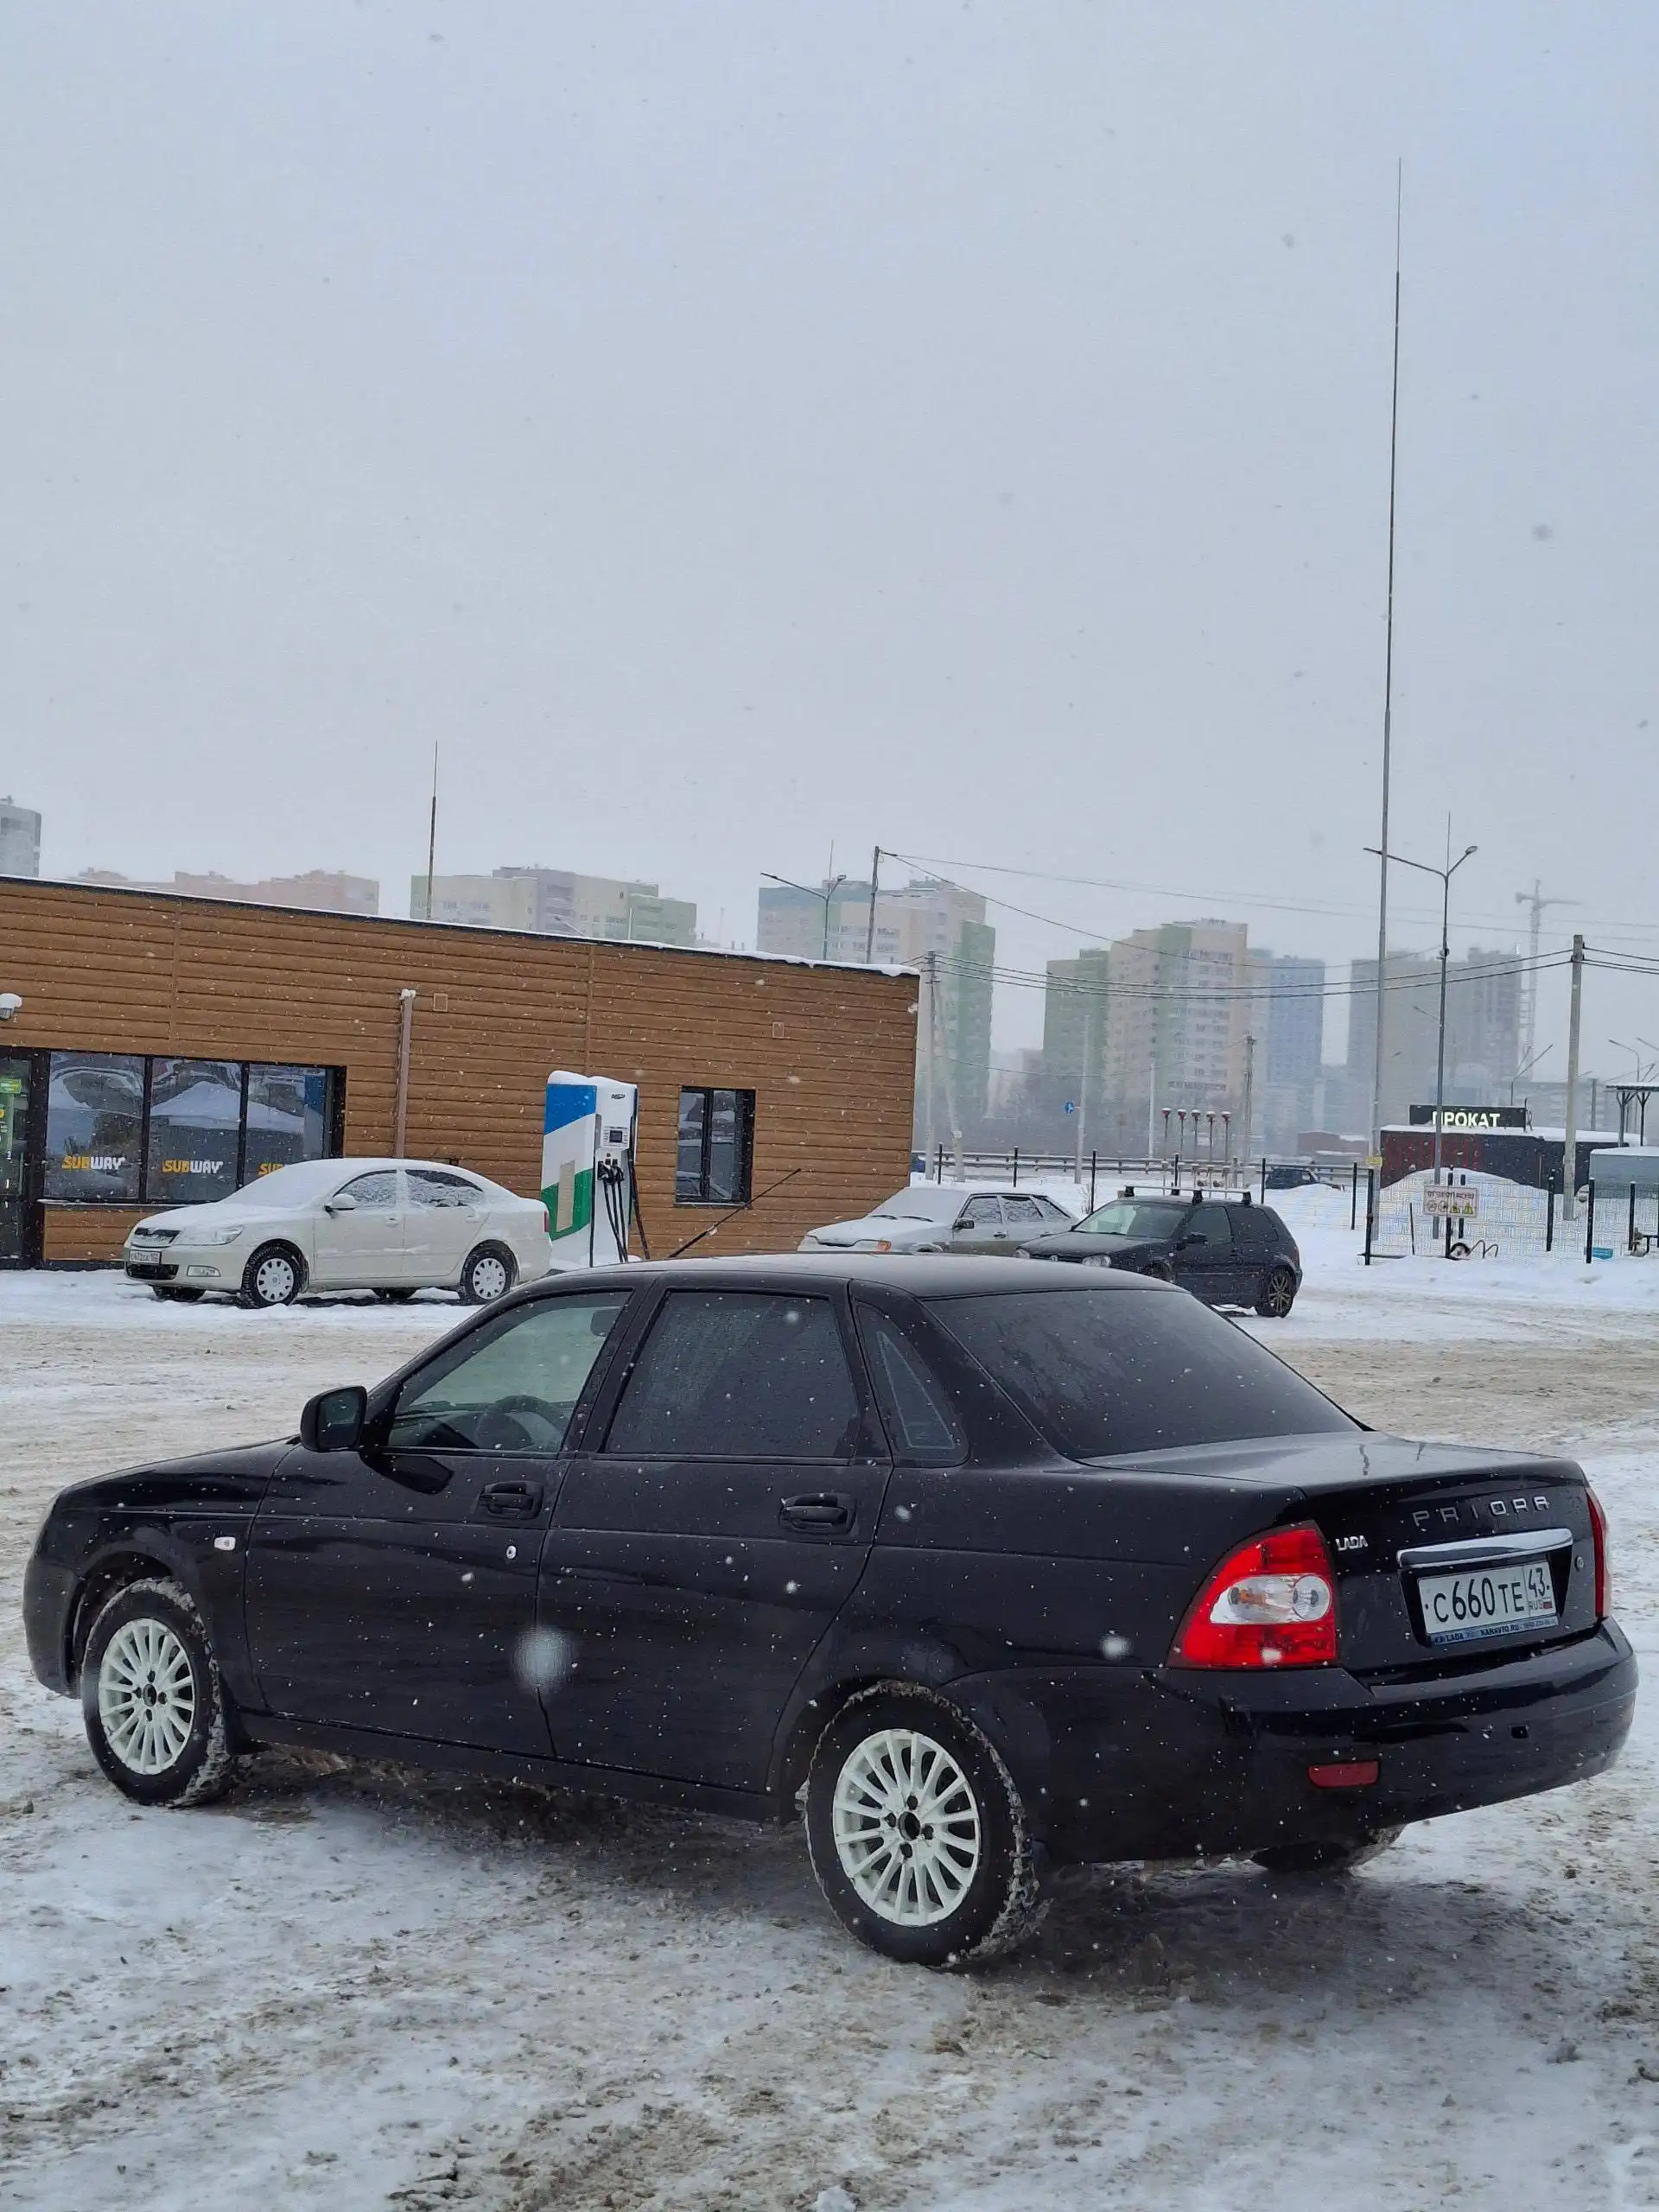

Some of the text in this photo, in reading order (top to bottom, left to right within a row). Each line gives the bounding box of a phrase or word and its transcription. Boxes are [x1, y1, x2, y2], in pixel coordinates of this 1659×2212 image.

[1432, 1110, 1501, 1128] ПРОКАТ
[62, 1155, 126, 1170] SUBWAY
[162, 1160, 224, 1173] SUBWAY
[1411, 1496, 1551, 1528] PRIORA
[1335, 1535, 1369, 1551] LADA
